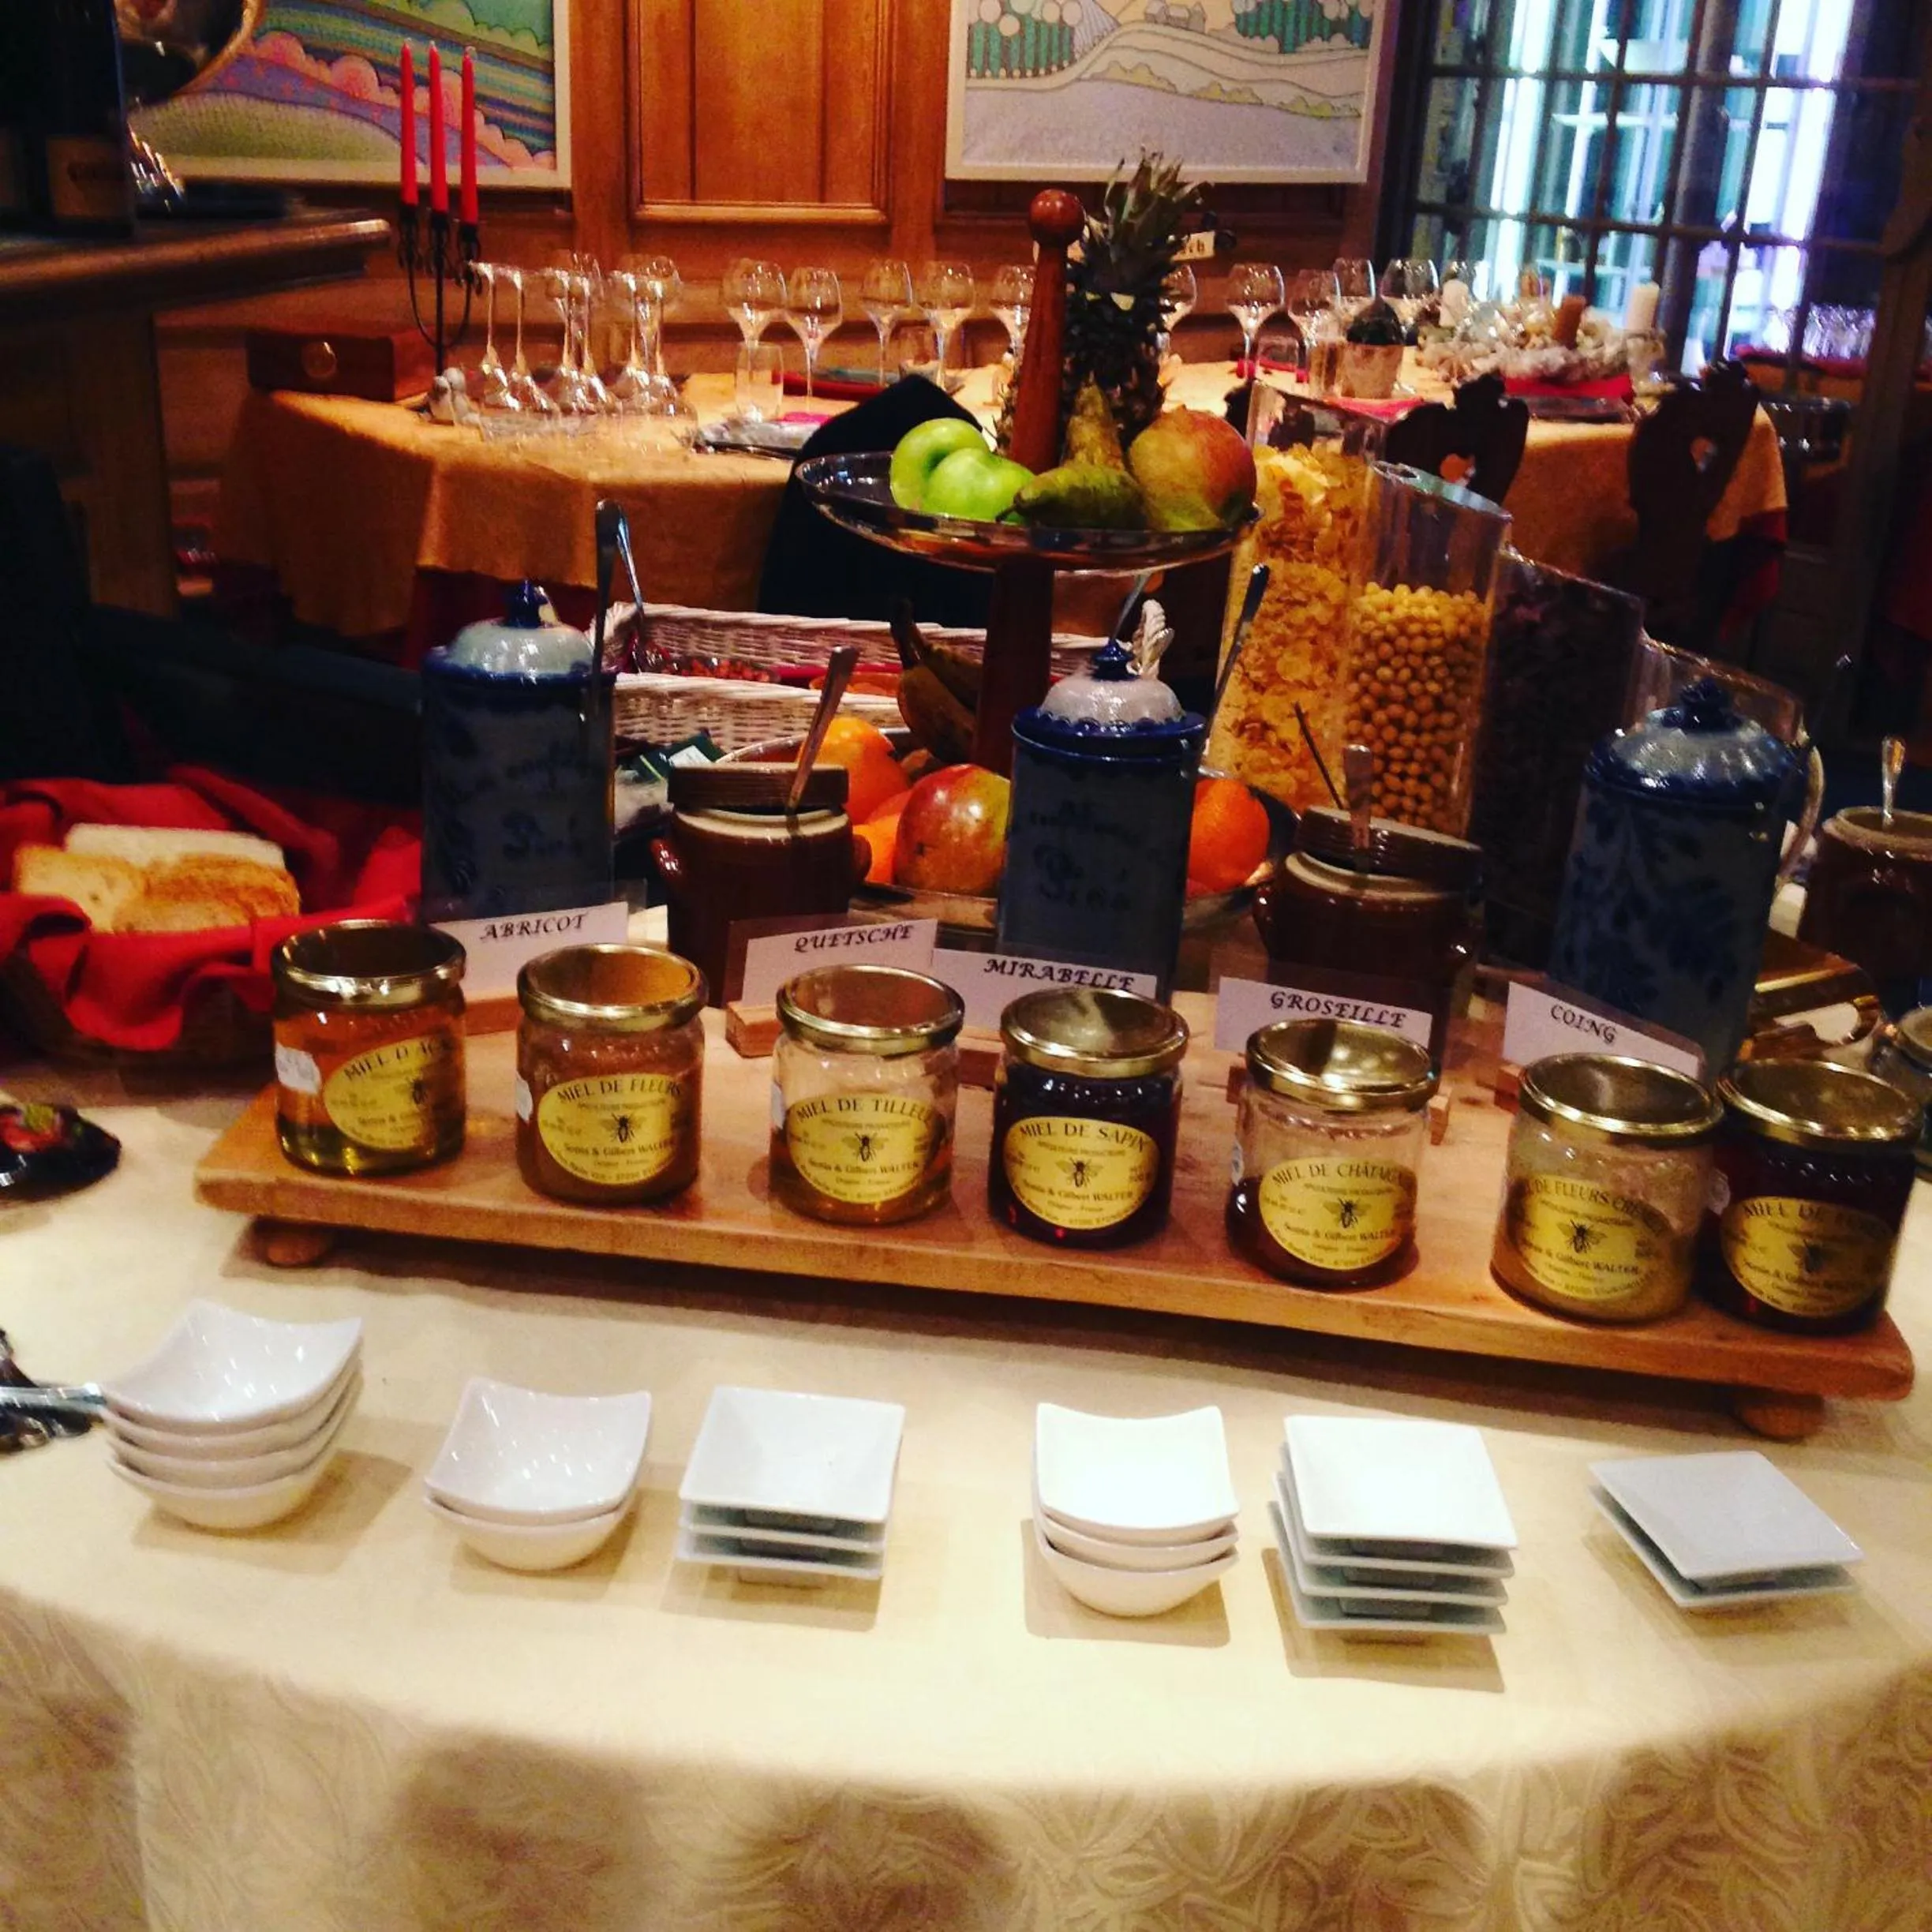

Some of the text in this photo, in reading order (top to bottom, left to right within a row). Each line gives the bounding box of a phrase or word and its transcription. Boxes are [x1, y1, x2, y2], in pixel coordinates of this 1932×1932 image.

[479, 912, 589, 940] ABRICOT
[794, 924, 914, 953] QUETSCHE
[983, 957, 1135, 990] MIRABELLE
[1270, 990, 1406, 1028] GROSEILLE
[1549, 1003, 1618, 1045] COING
[343, 1054, 388, 1081] MIEL
[556, 1079, 682, 1103] MIEL DE FLEURS
[796, 1099, 934, 1123] MIEL DE TILLEU
[1020, 1122, 1054, 1138] MIEL
[1064, 1122, 1088, 1136] DE
[1096, 1126, 1148, 1153] SAPIN
[1272, 1165, 1304, 1186] MIEL
[1309, 1163, 1329, 1178] DE
[1556, 1181, 1611, 1205] FLEURS
